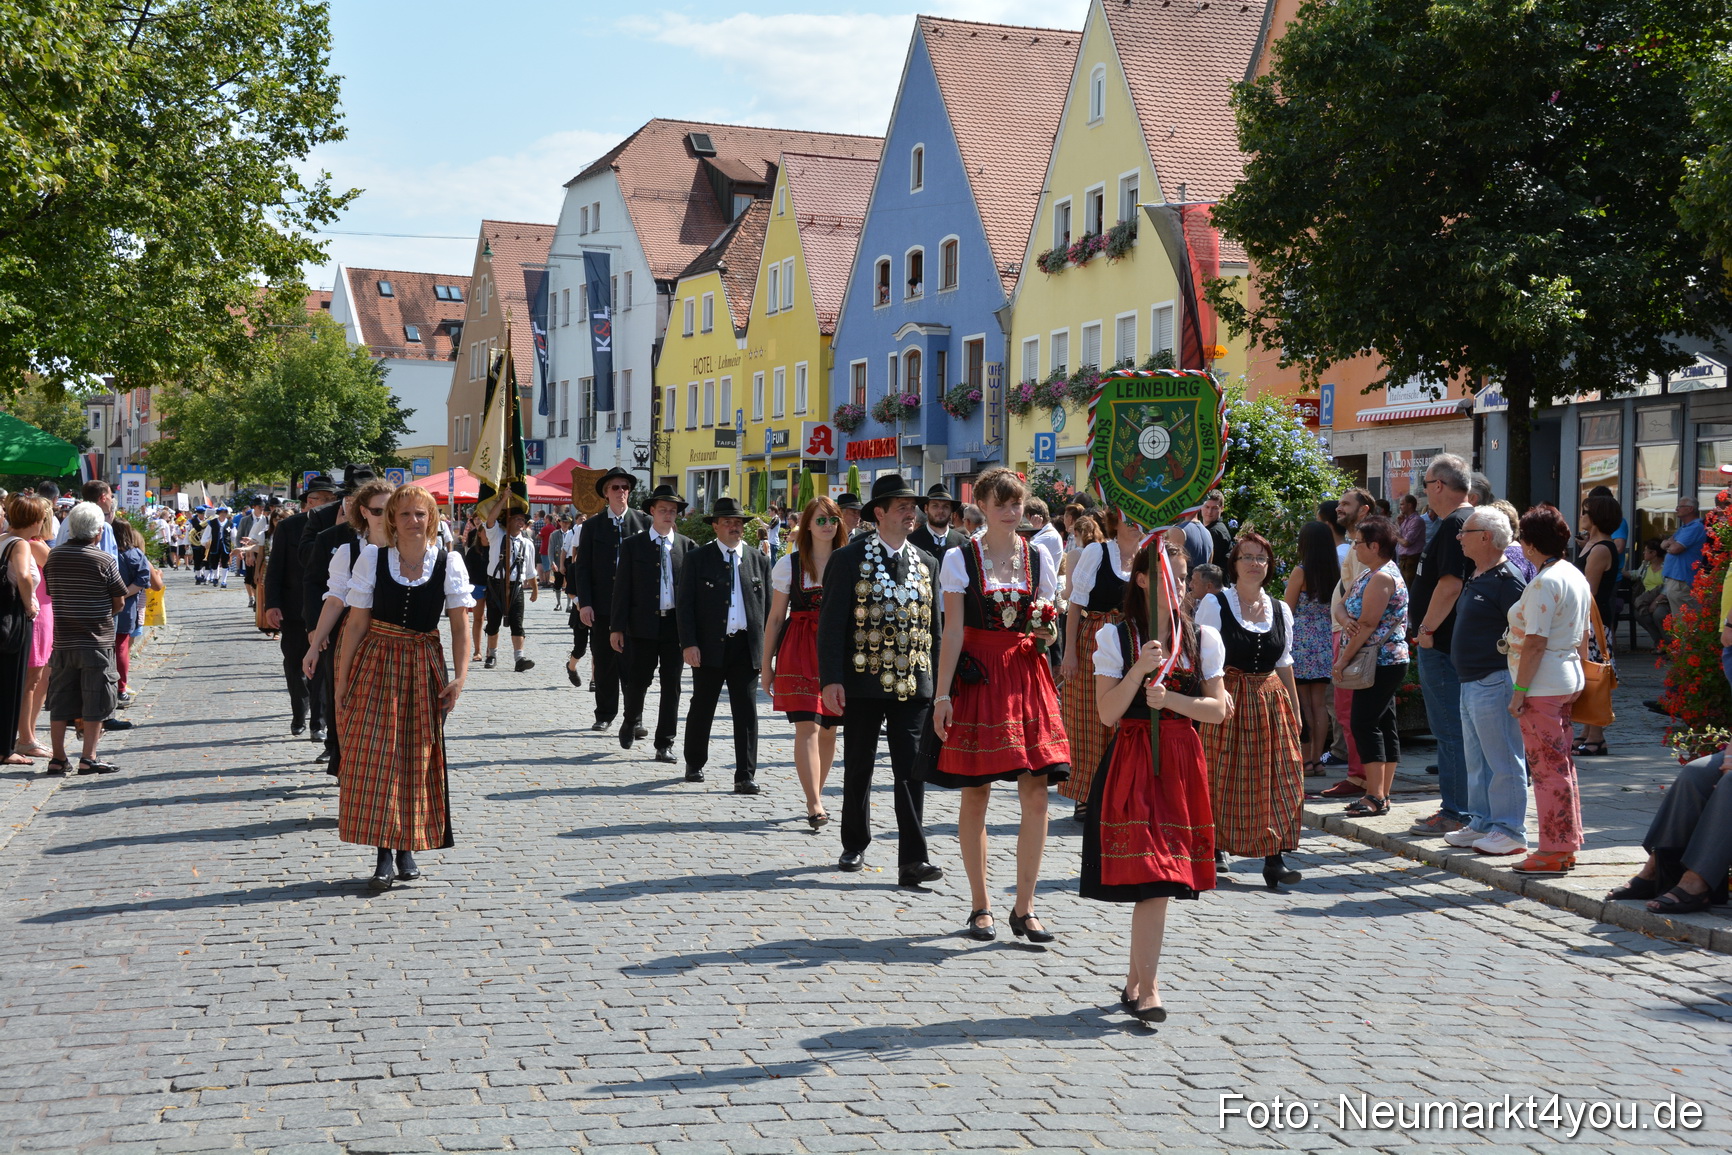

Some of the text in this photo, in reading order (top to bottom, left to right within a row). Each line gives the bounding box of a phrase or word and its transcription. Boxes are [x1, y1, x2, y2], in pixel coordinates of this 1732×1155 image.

[594, 306, 611, 352] K&L
[692, 353, 741, 375] HOTEL Lehmeier
[987, 363, 1001, 376] CAFÉ
[1116, 380, 1201, 398] LEINBURG
[988, 378, 1000, 438] WITTL
[1323, 389, 1332, 420] P
[766, 431, 771, 451] P
[844, 437, 897, 460] APOTHEKE
[1039, 436, 1051, 460] P
[1491, 439, 1499, 450] 16
[689, 448, 718, 463] Restaurant
